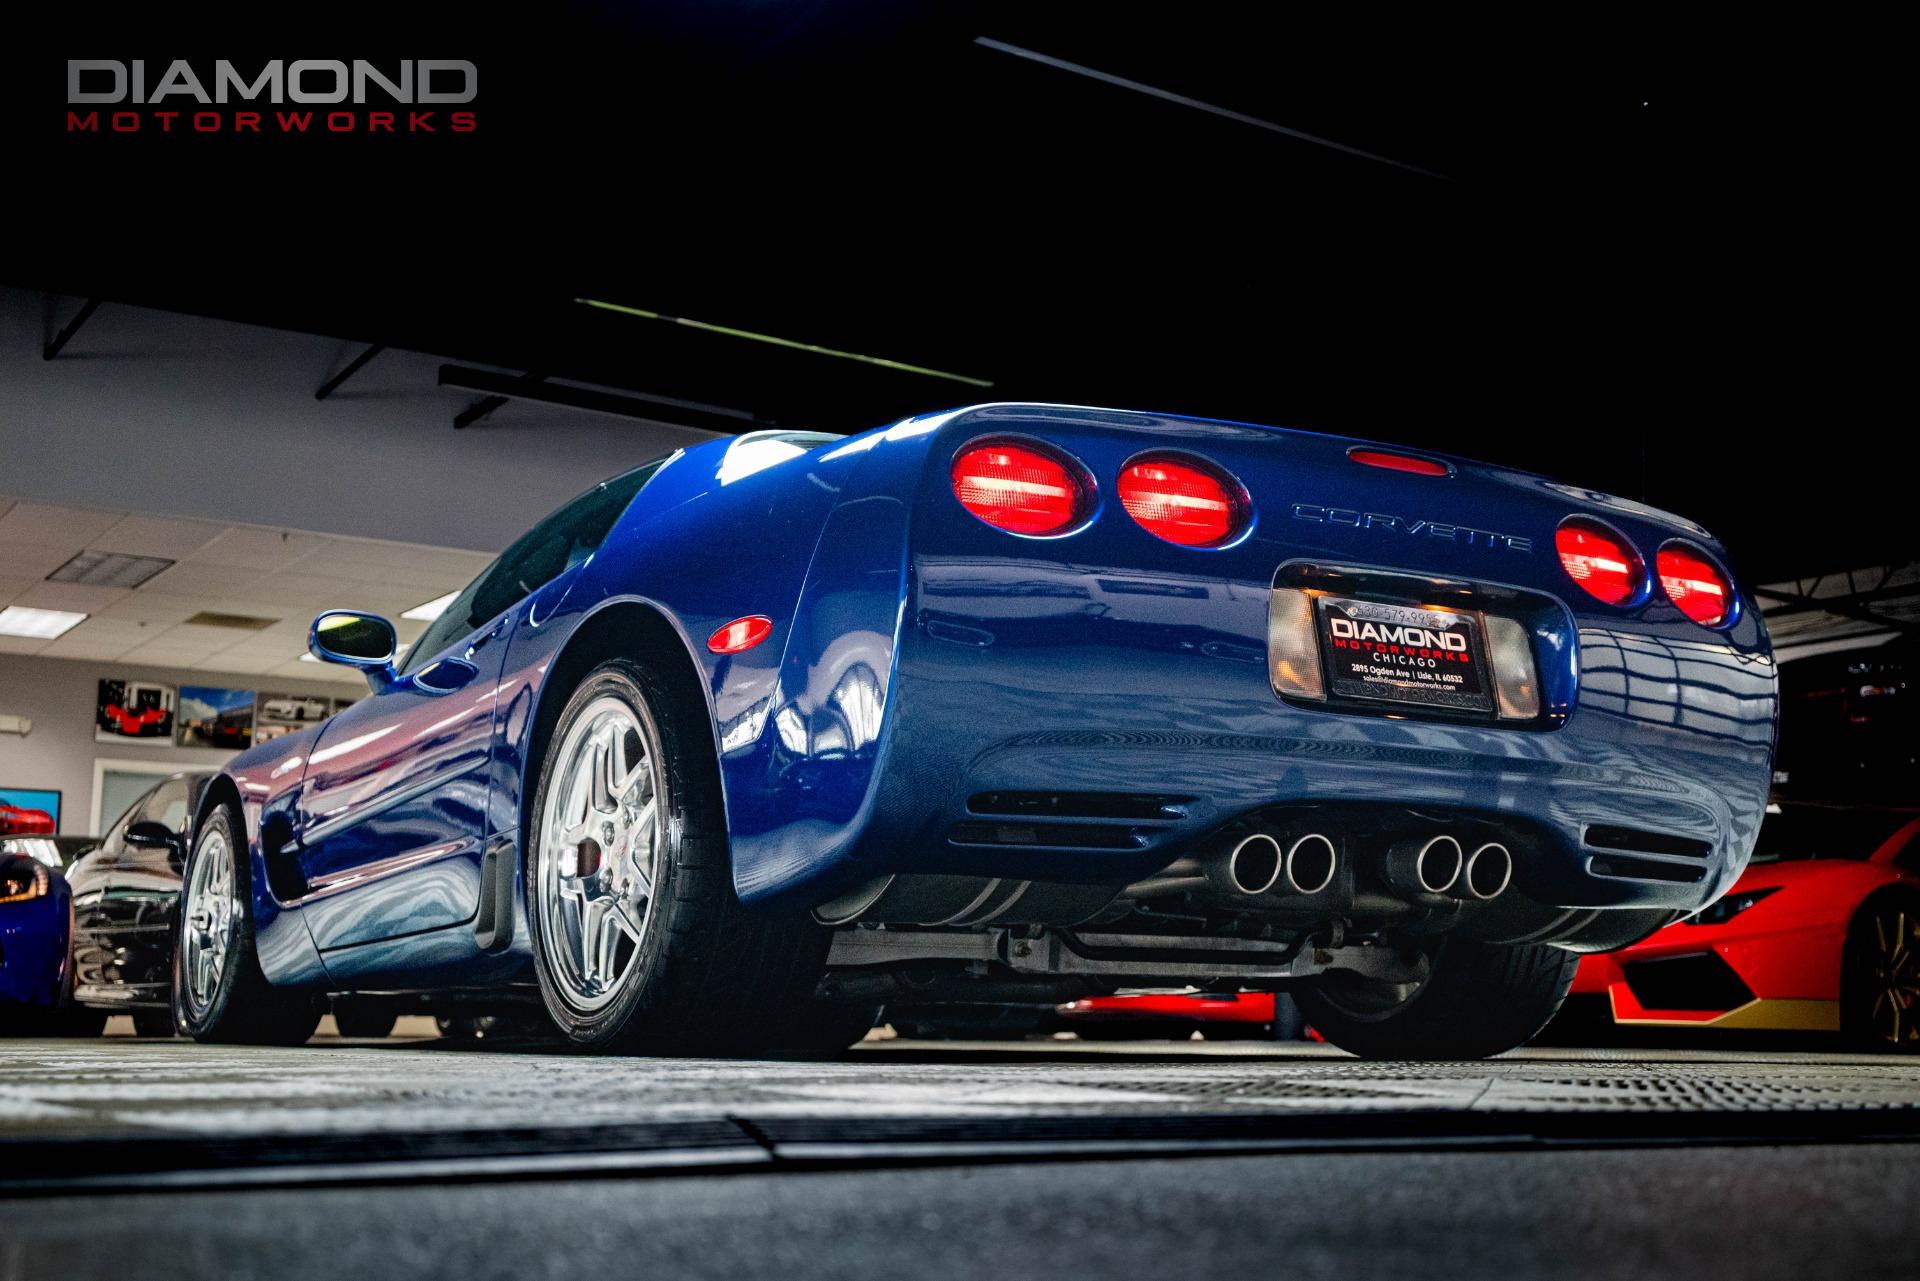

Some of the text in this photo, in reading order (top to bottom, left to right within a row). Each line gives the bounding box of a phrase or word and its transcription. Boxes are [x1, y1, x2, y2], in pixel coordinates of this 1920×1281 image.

[1291, 503, 1533, 553] CORVETTE
[1330, 618, 1466, 652] DIAMOND
[1334, 639, 1469, 663] MOTORWORKS
[1373, 652, 1436, 668] CHICAGO
[1351, 663, 1369, 673] 2895
[1369, 666, 1395, 677] Ogden
[1396, 669, 1410, 678] Ave
[1435, 672, 1441, 681] IL
[1442, 674, 1464, 684] 60532
[1363, 675, 1456, 691] sales@diamondmotorworks.com
